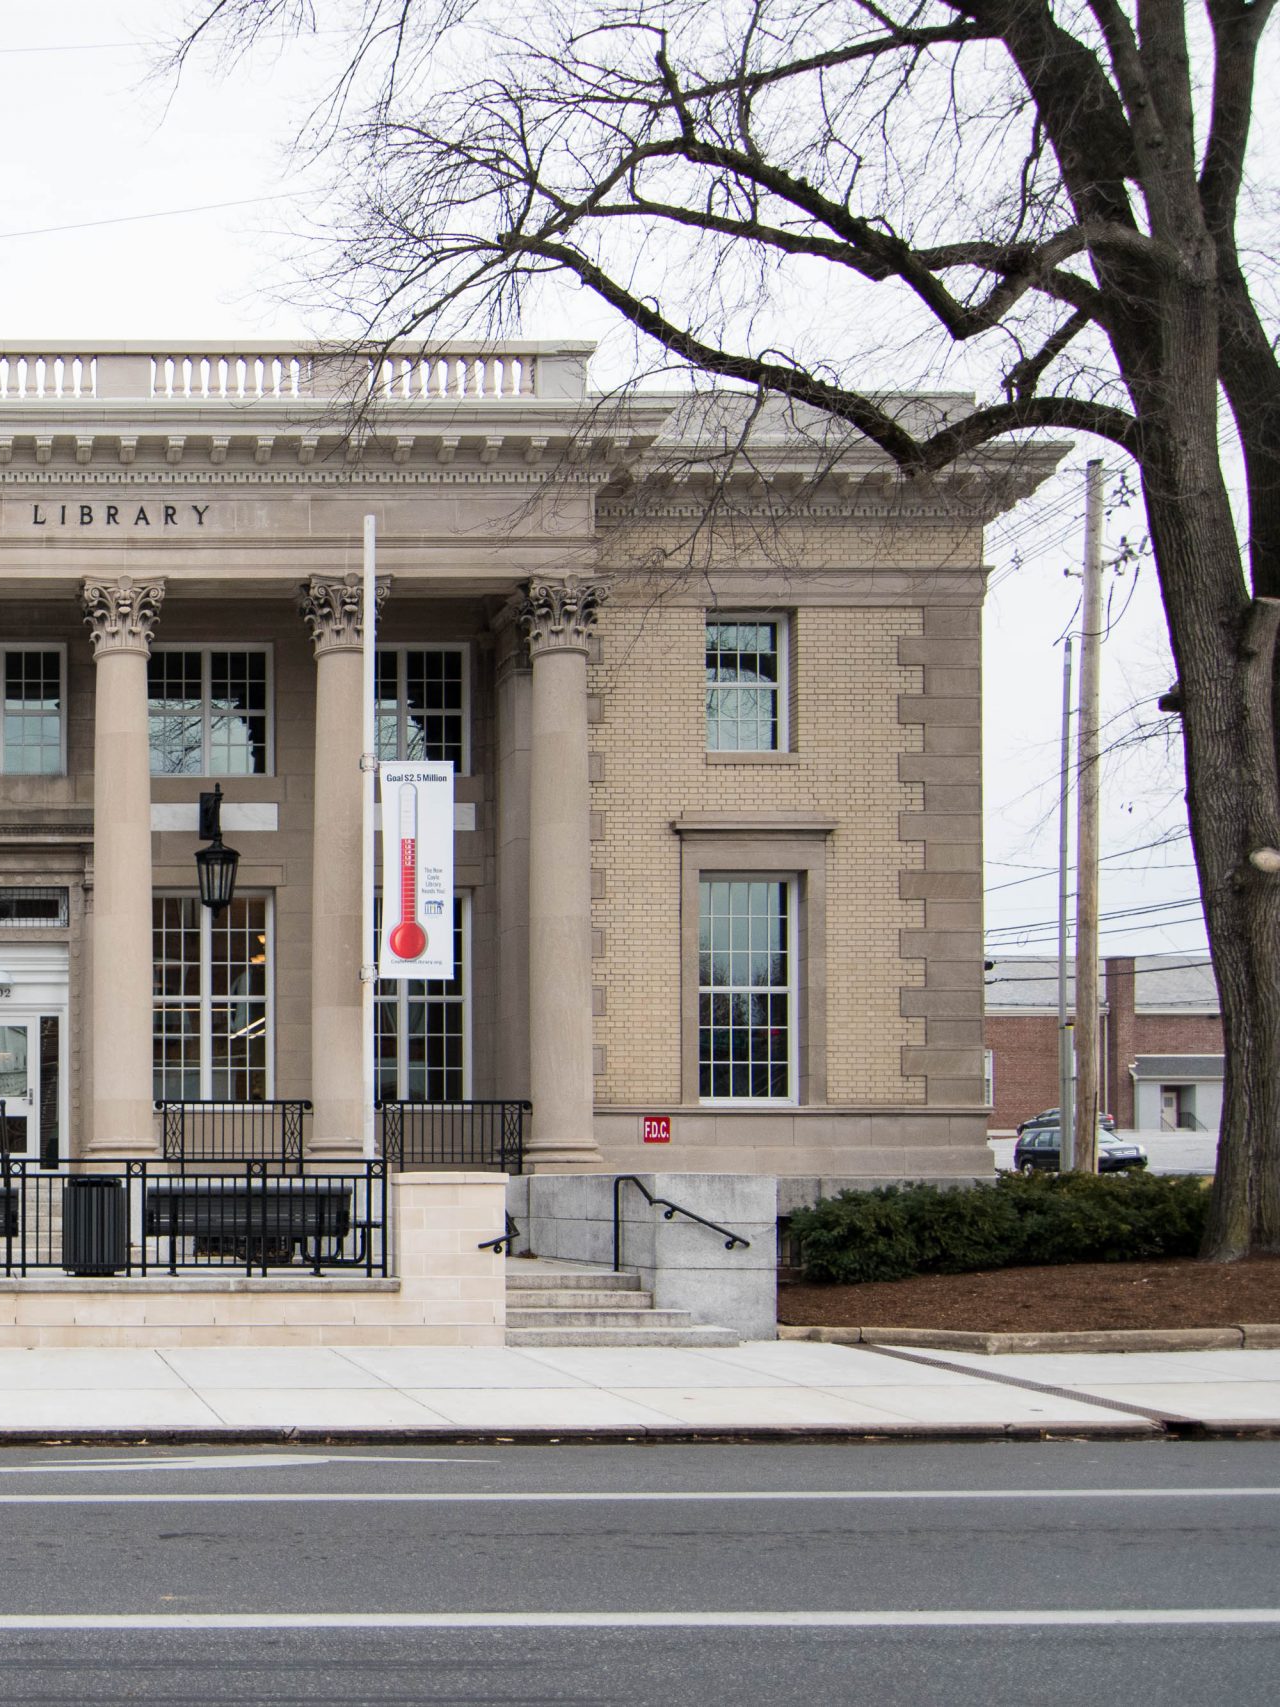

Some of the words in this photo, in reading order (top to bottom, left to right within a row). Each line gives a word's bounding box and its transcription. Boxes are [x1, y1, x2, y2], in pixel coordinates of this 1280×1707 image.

[32, 504, 210, 526] LIBRARY
[386, 774, 403, 782] Goal
[422, 774, 447, 782] Million
[644, 1121, 669, 1138] F.D.C.
